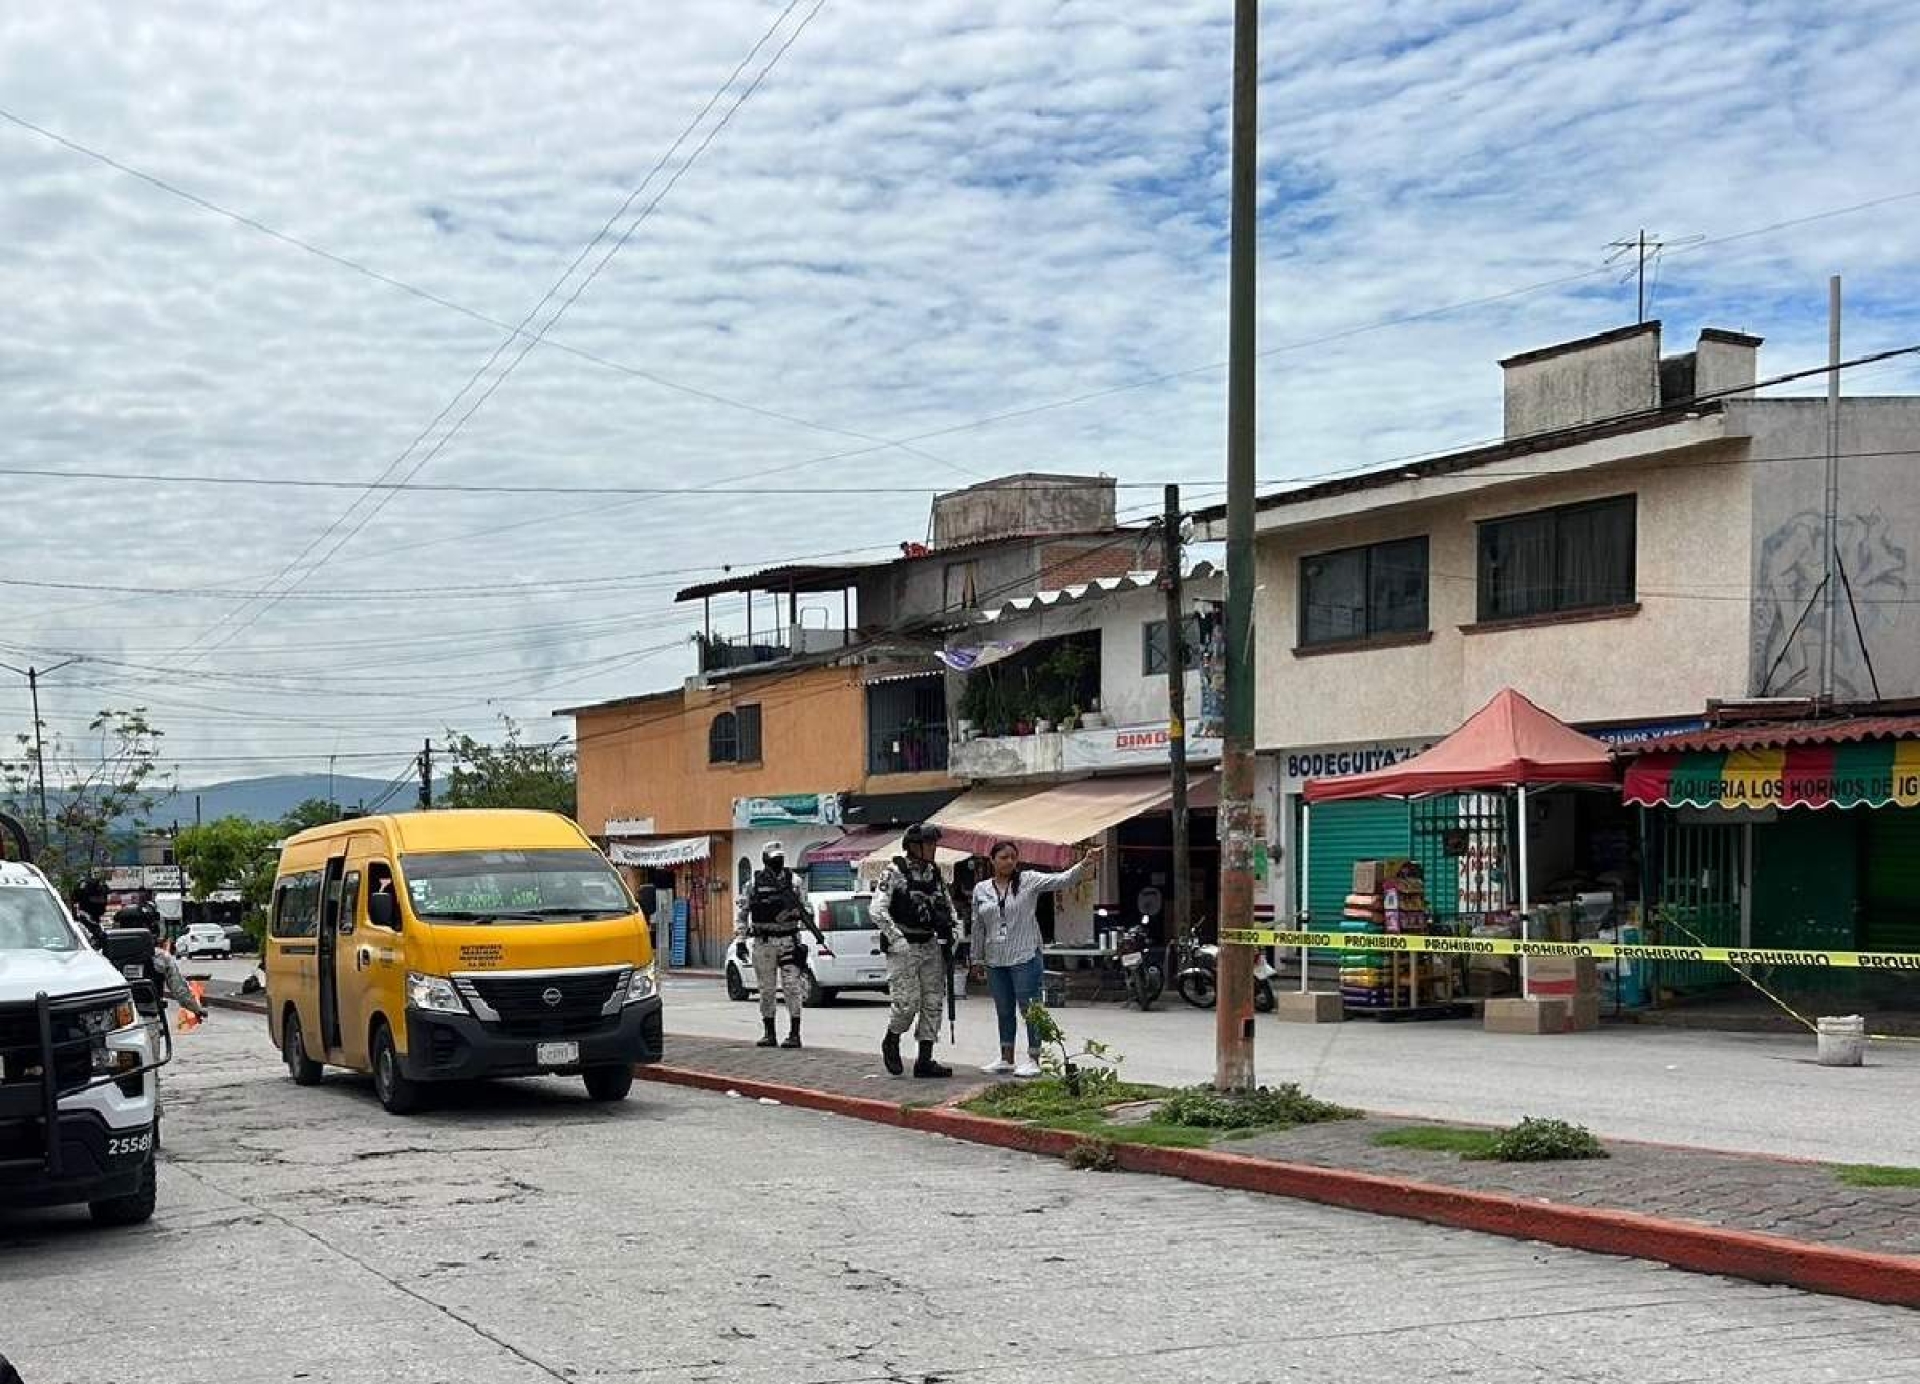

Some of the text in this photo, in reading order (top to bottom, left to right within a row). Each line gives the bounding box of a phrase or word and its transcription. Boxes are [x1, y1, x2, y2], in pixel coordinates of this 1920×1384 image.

[1665, 779, 1745, 798] TAQUERIA
[1751, 778, 1785, 798] LOS
[1791, 778, 1865, 798] HORNOS
[1871, 778, 1893, 797] DE
[1273, 932, 1330, 946] PROHIBIDO
[1344, 936, 1407, 949] PROHIBIDO
[1424, 938, 1494, 953] PROHIBIDO
[1513, 943, 1593, 958] PROHIBIDO
[1614, 946, 1703, 961] PROHIBIDO
[1727, 951, 1830, 966] PROHIBIDO
